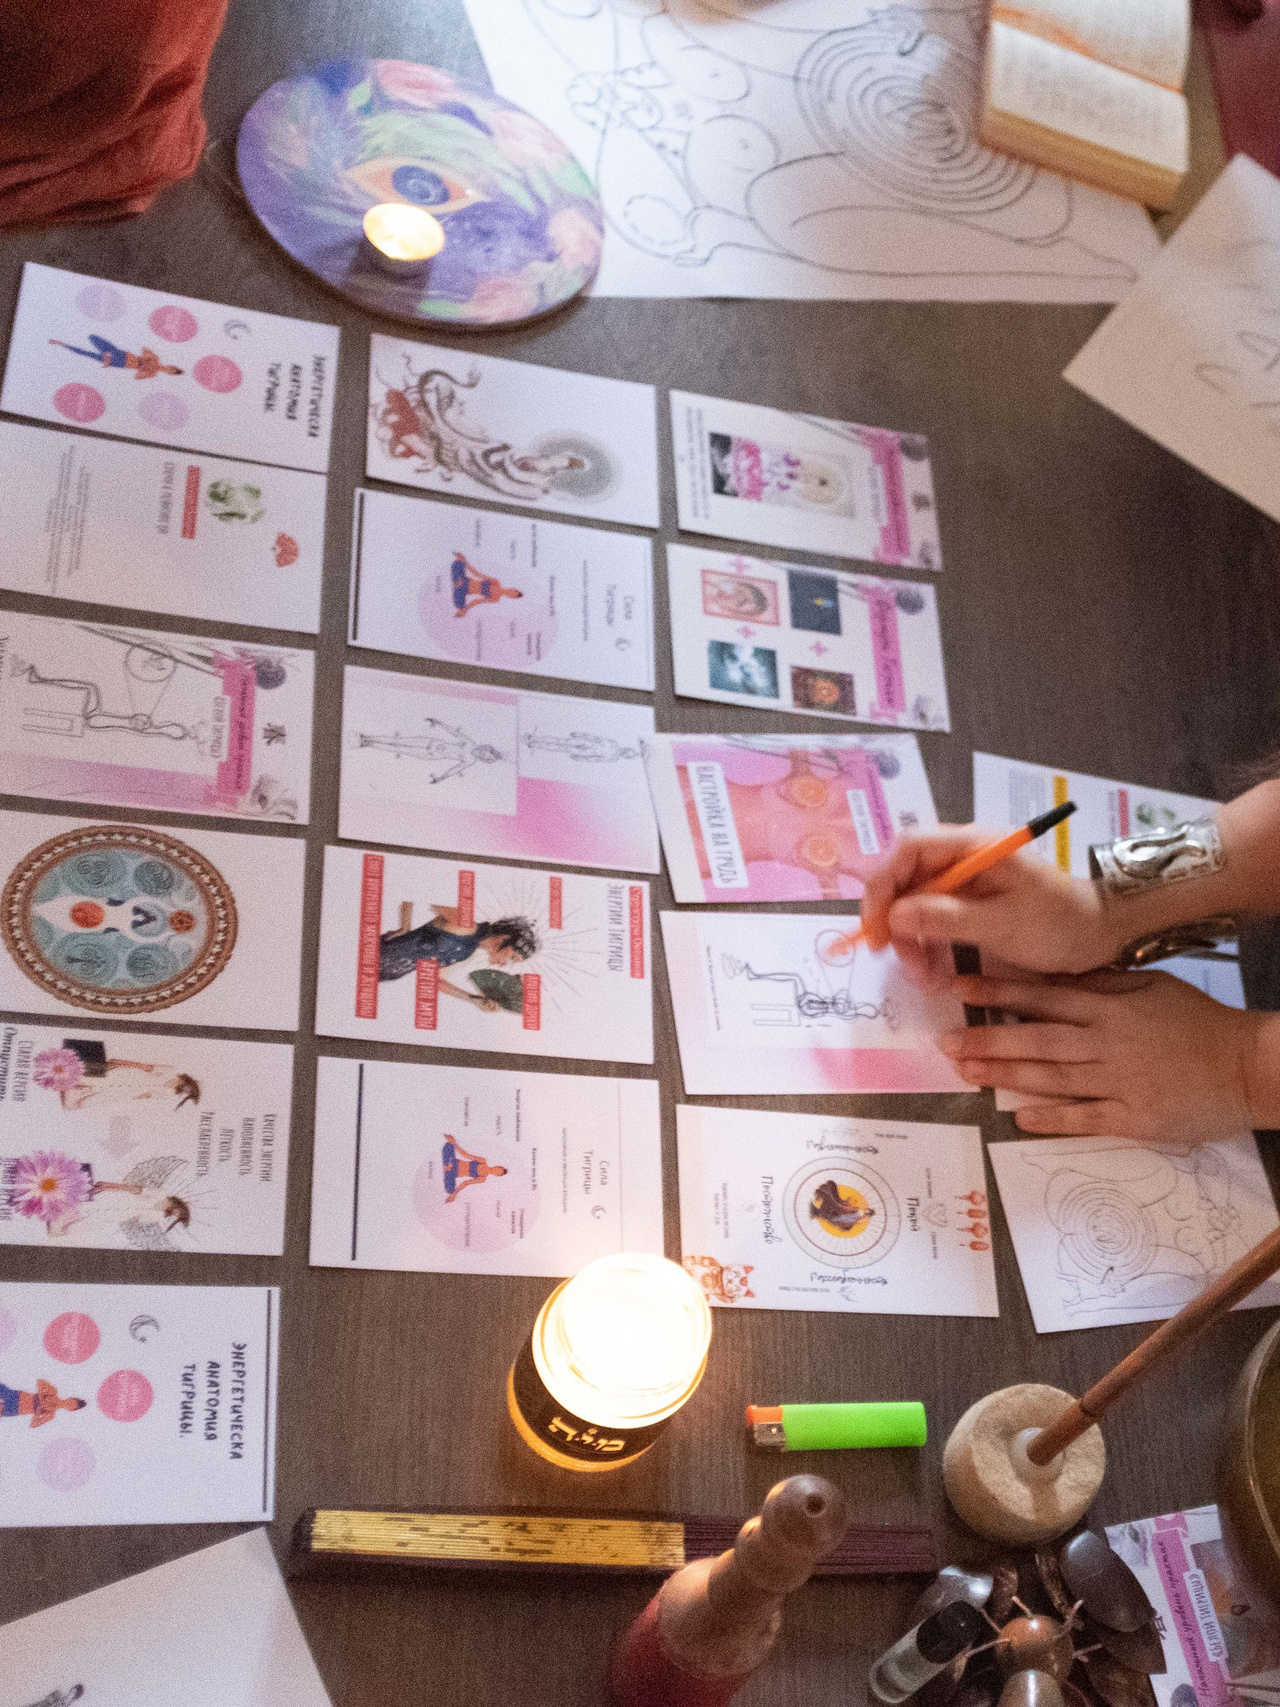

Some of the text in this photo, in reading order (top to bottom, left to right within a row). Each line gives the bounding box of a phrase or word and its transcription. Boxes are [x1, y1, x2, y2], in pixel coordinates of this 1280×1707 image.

[285, 363, 303, 421] АНАТОМИЯ
[695, 766, 739, 885] НАСТРОЙКА НА ГРУДЬ
[12, 1040, 35, 1102] СТАРАЯ ВЕРСИЯ
[259, 1113, 278, 1182] КАЧЕСТВА ЭНЕРГИИ
[581, 1149, 594, 1195] Тигрицы
[599, 1160, 610, 1186] Сила
[179, 1363, 197, 1438] ТИГРИЦЫ.
[204, 1360, 222, 1441] АНАТОМИЯ
[229, 1342, 247, 1460] ЭНЕРГЕТИЧЕСКА
[1158, 1541, 1213, 1698] Начальный уровень практик
[1188, 1573, 1213, 1620] ТИГРИЦЫ»
